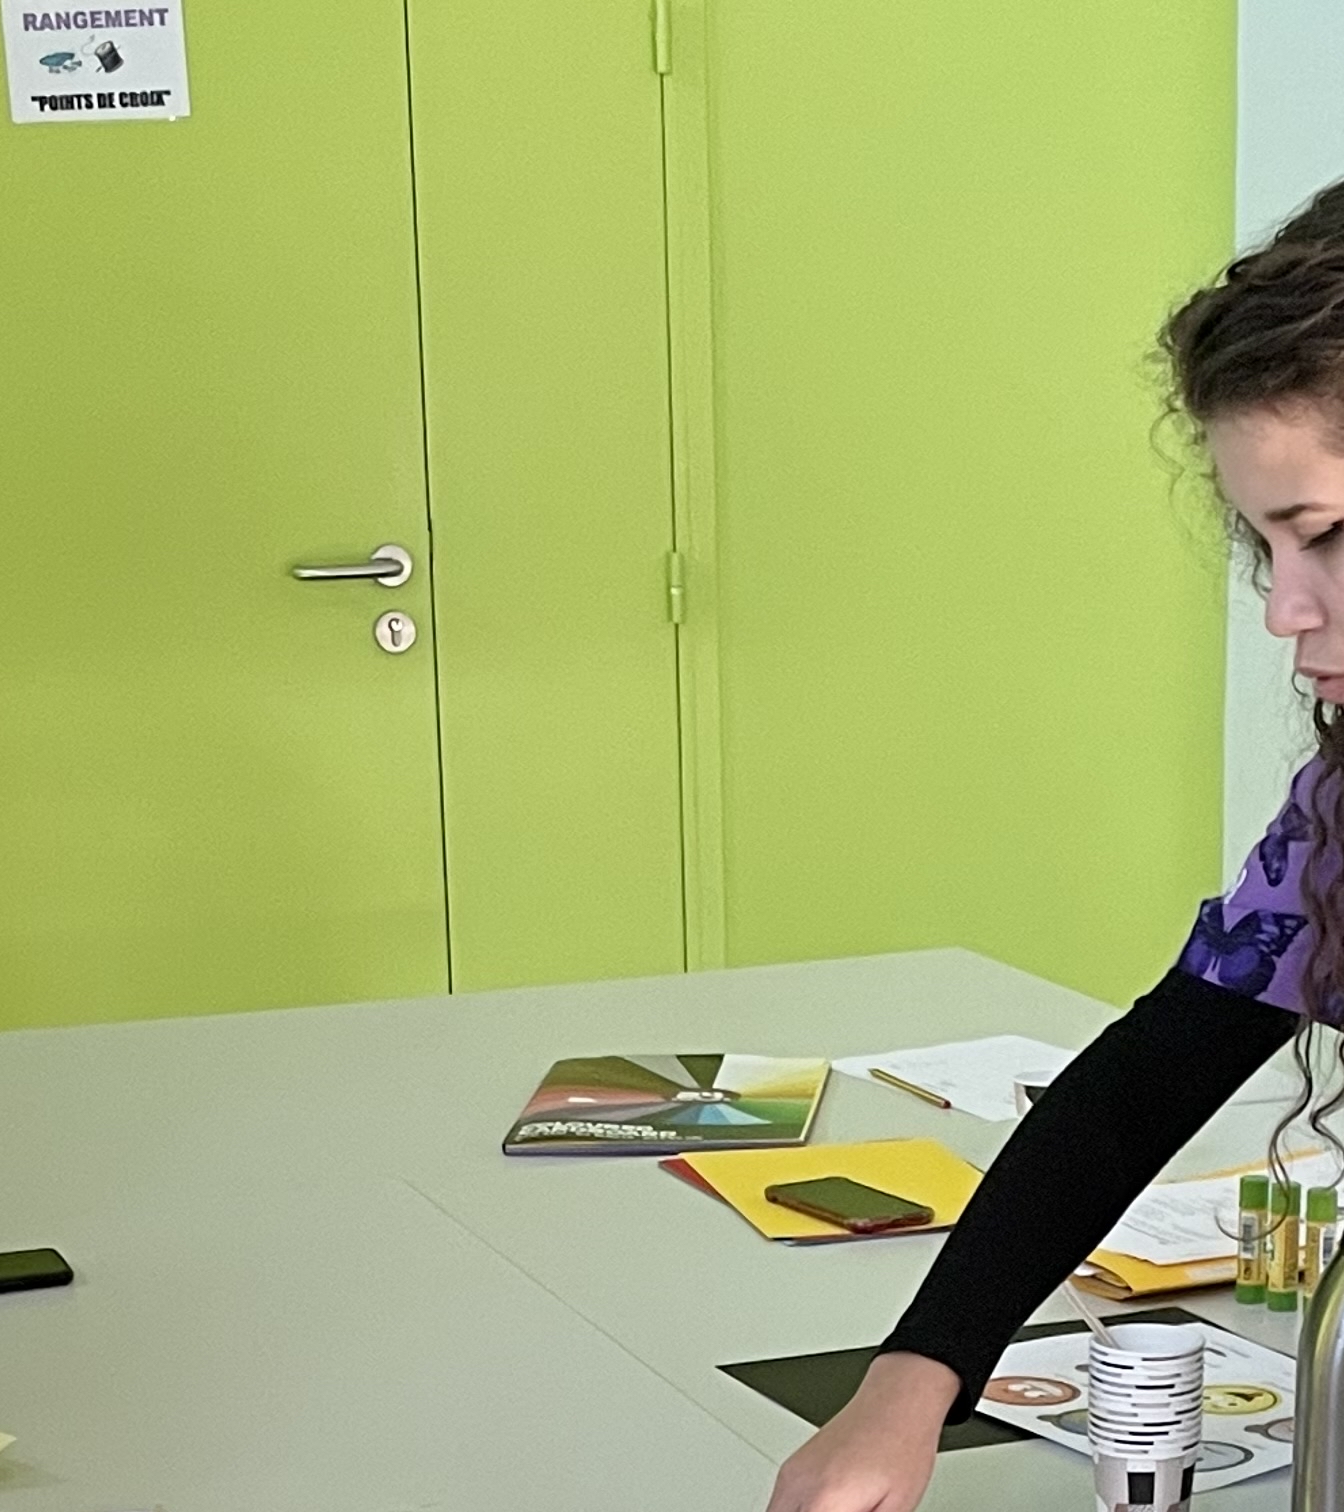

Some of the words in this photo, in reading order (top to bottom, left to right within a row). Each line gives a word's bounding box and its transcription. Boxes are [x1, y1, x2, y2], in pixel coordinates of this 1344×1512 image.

[23, 8, 169, 31] RANGEMENT
[31, 93, 94, 112] "POINTS
[97, 92, 116, 109] DE
[119, 90, 171, 108] CROIX"
